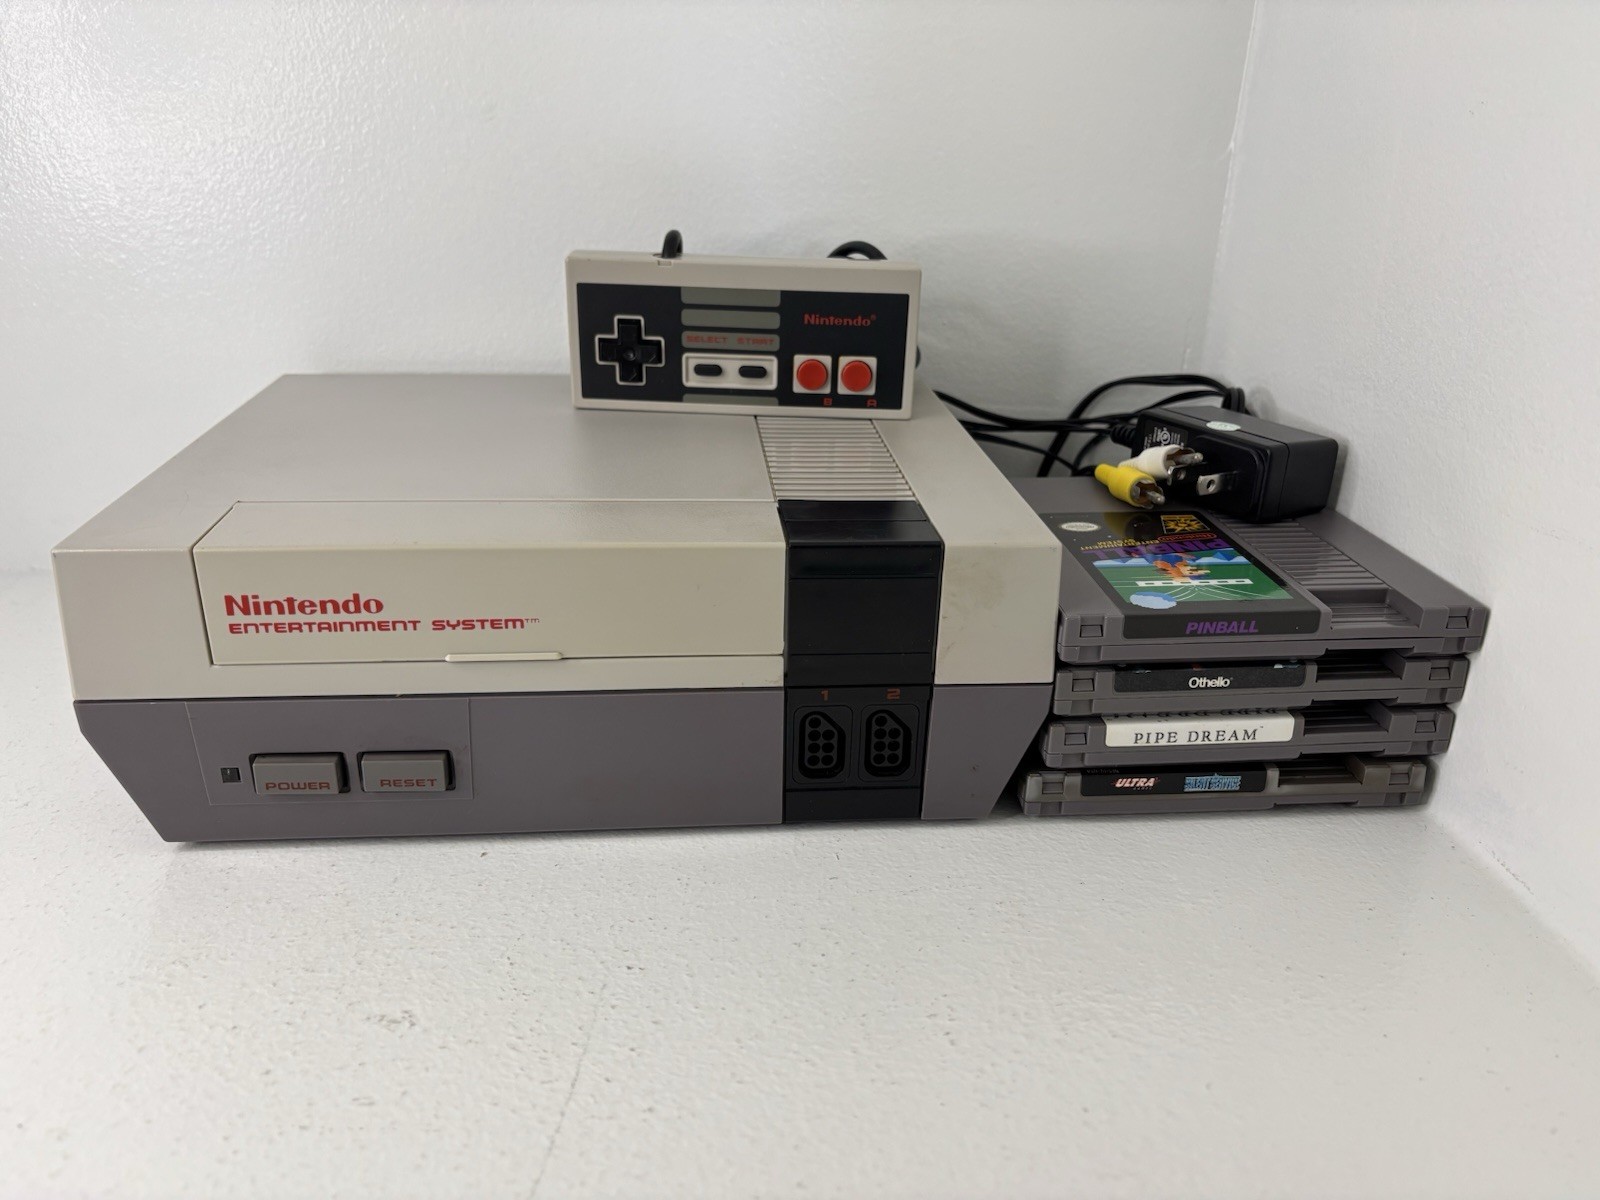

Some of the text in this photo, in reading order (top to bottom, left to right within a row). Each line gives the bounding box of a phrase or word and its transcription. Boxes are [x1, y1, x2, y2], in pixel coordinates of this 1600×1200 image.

[686, 334, 728, 345] SELECT
[736, 337, 774, 347] START
[823, 397, 832, 406] B
[866, 400, 877, 408] A
[224, 593, 384, 616] Nintendo
[229, 620, 421, 635] ENTERTAINMENT
[1185, 621, 1259, 634] PINBALL
[1188, 676, 1231, 689] Othello
[821, 690, 829, 701] 1
[886, 688, 900, 700] 2
[1133, 732, 1178, 744] PIPE
[265, 782, 330, 791] POWER
[380, 778, 438, 788] RESET
[1115, 777, 1156, 788] ULTRA
